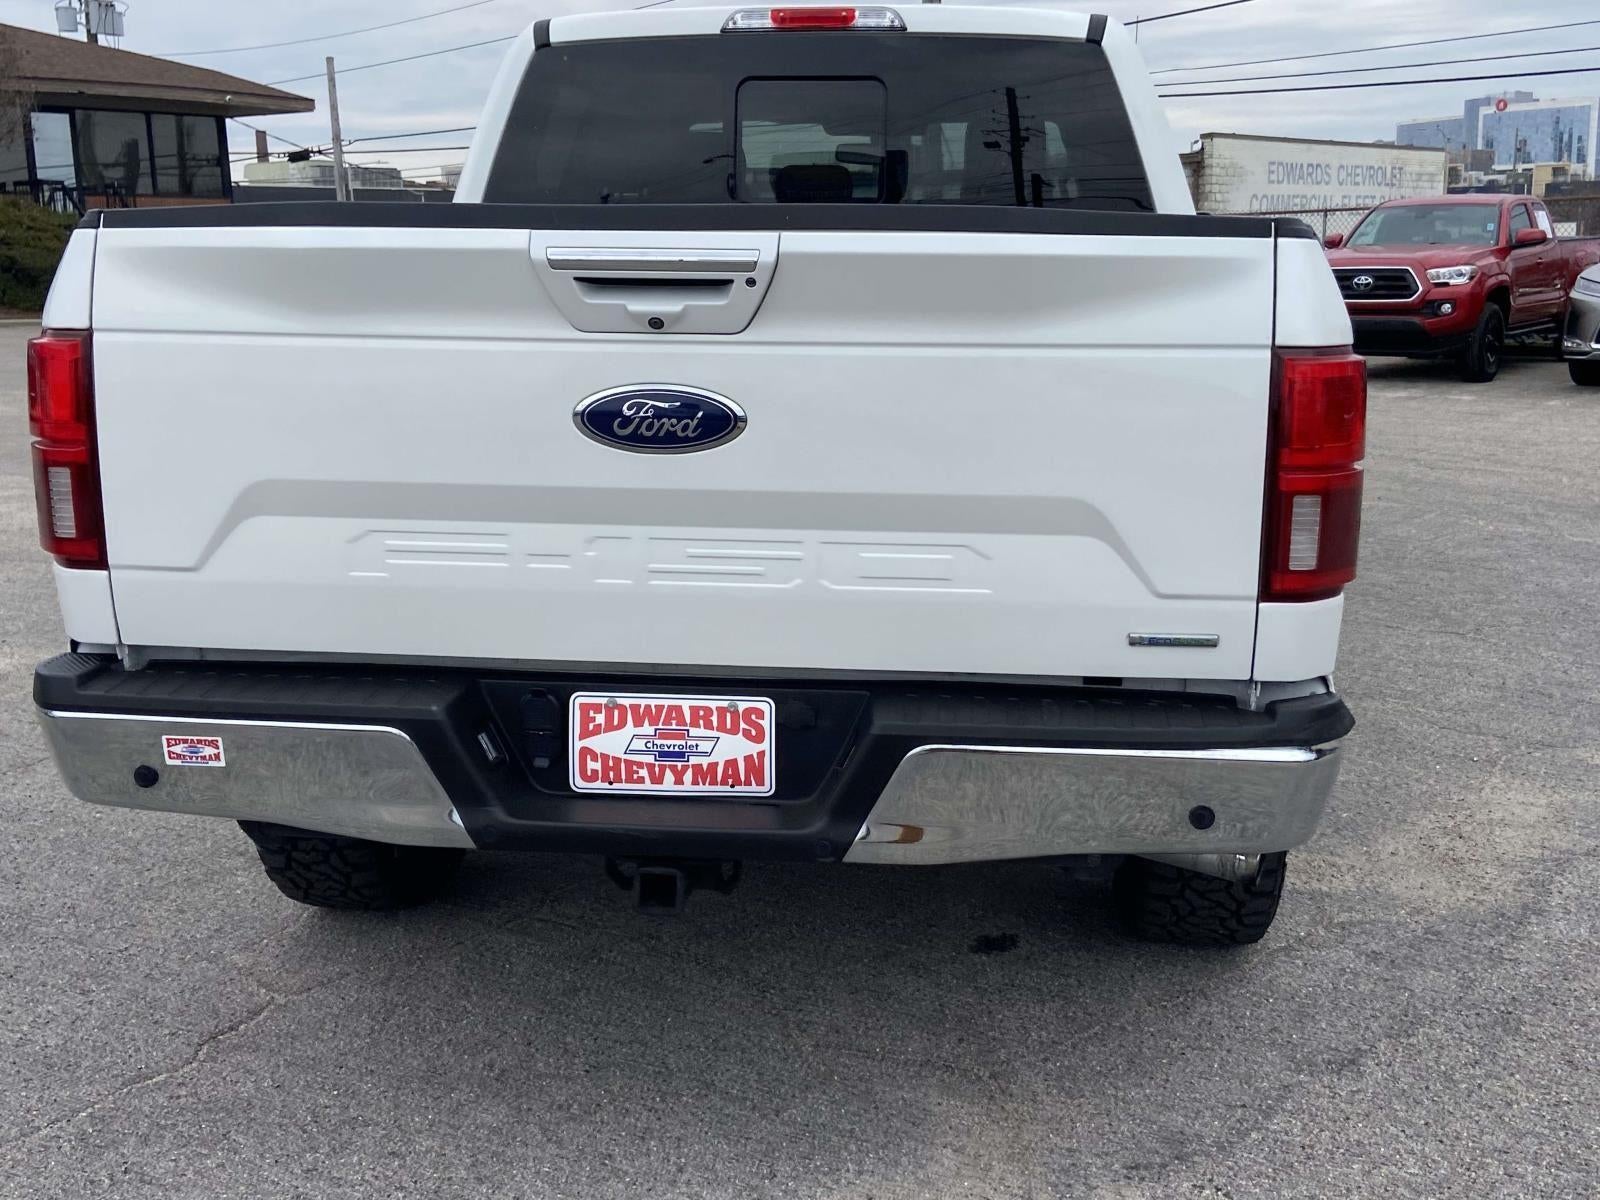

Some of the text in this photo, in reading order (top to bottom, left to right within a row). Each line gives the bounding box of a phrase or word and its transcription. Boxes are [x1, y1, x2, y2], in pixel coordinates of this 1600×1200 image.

[1267, 161, 1404, 188] EDWARDS CHEVROLET
[613, 399, 703, 437] Ford
[578, 702, 766, 745] EDWARDS
[165, 737, 220, 750] EDWARDS
[167, 750, 222, 762] CHEVYMAN
[644, 740, 700, 751] Chevrolet
[578, 745, 766, 787] CHEVYMAN
